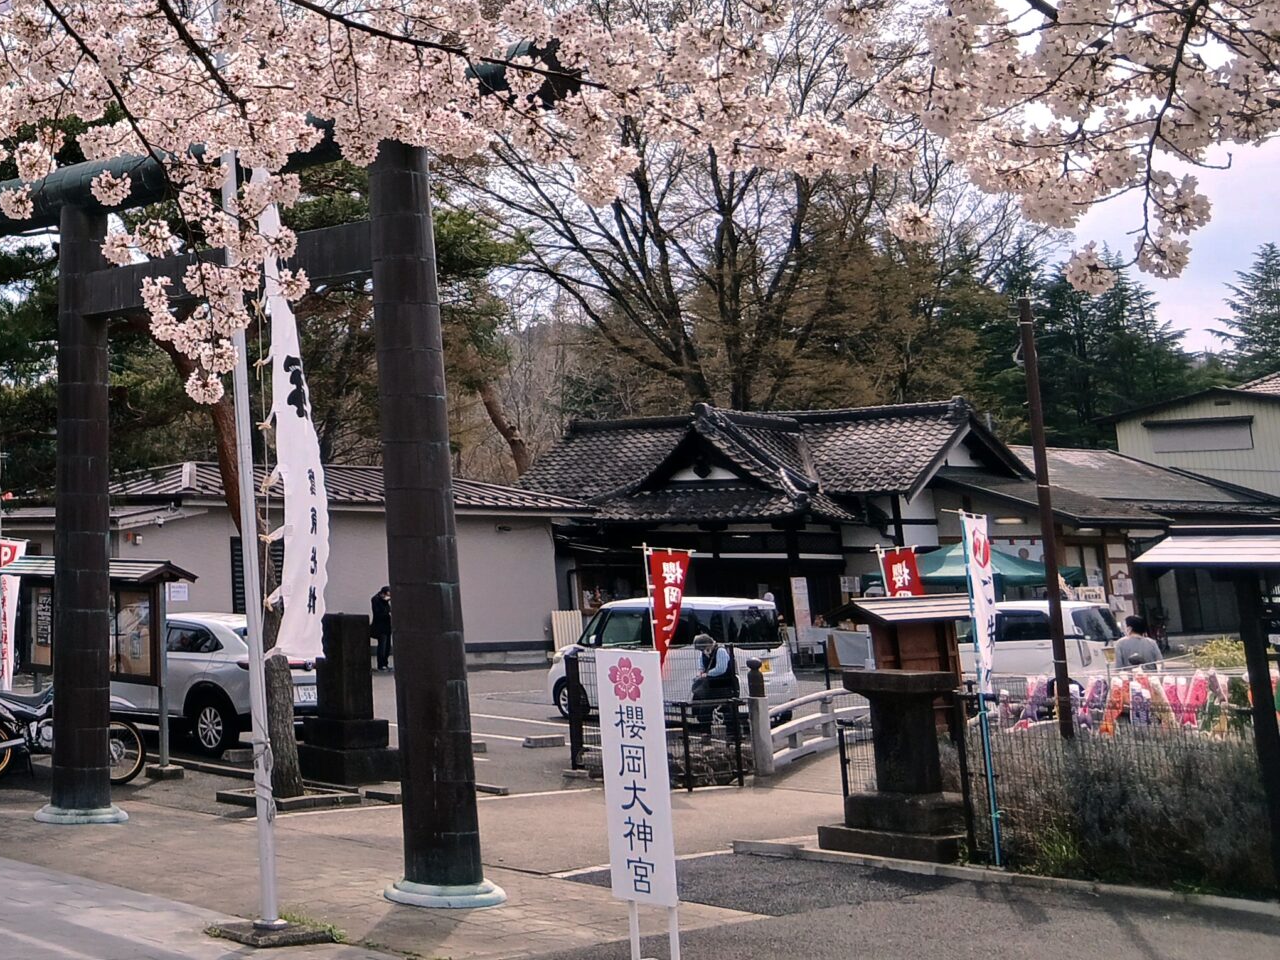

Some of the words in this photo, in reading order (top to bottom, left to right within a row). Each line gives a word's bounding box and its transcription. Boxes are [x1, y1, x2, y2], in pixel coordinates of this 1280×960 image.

[614, 704, 655, 894] 櫻岡大神宮
